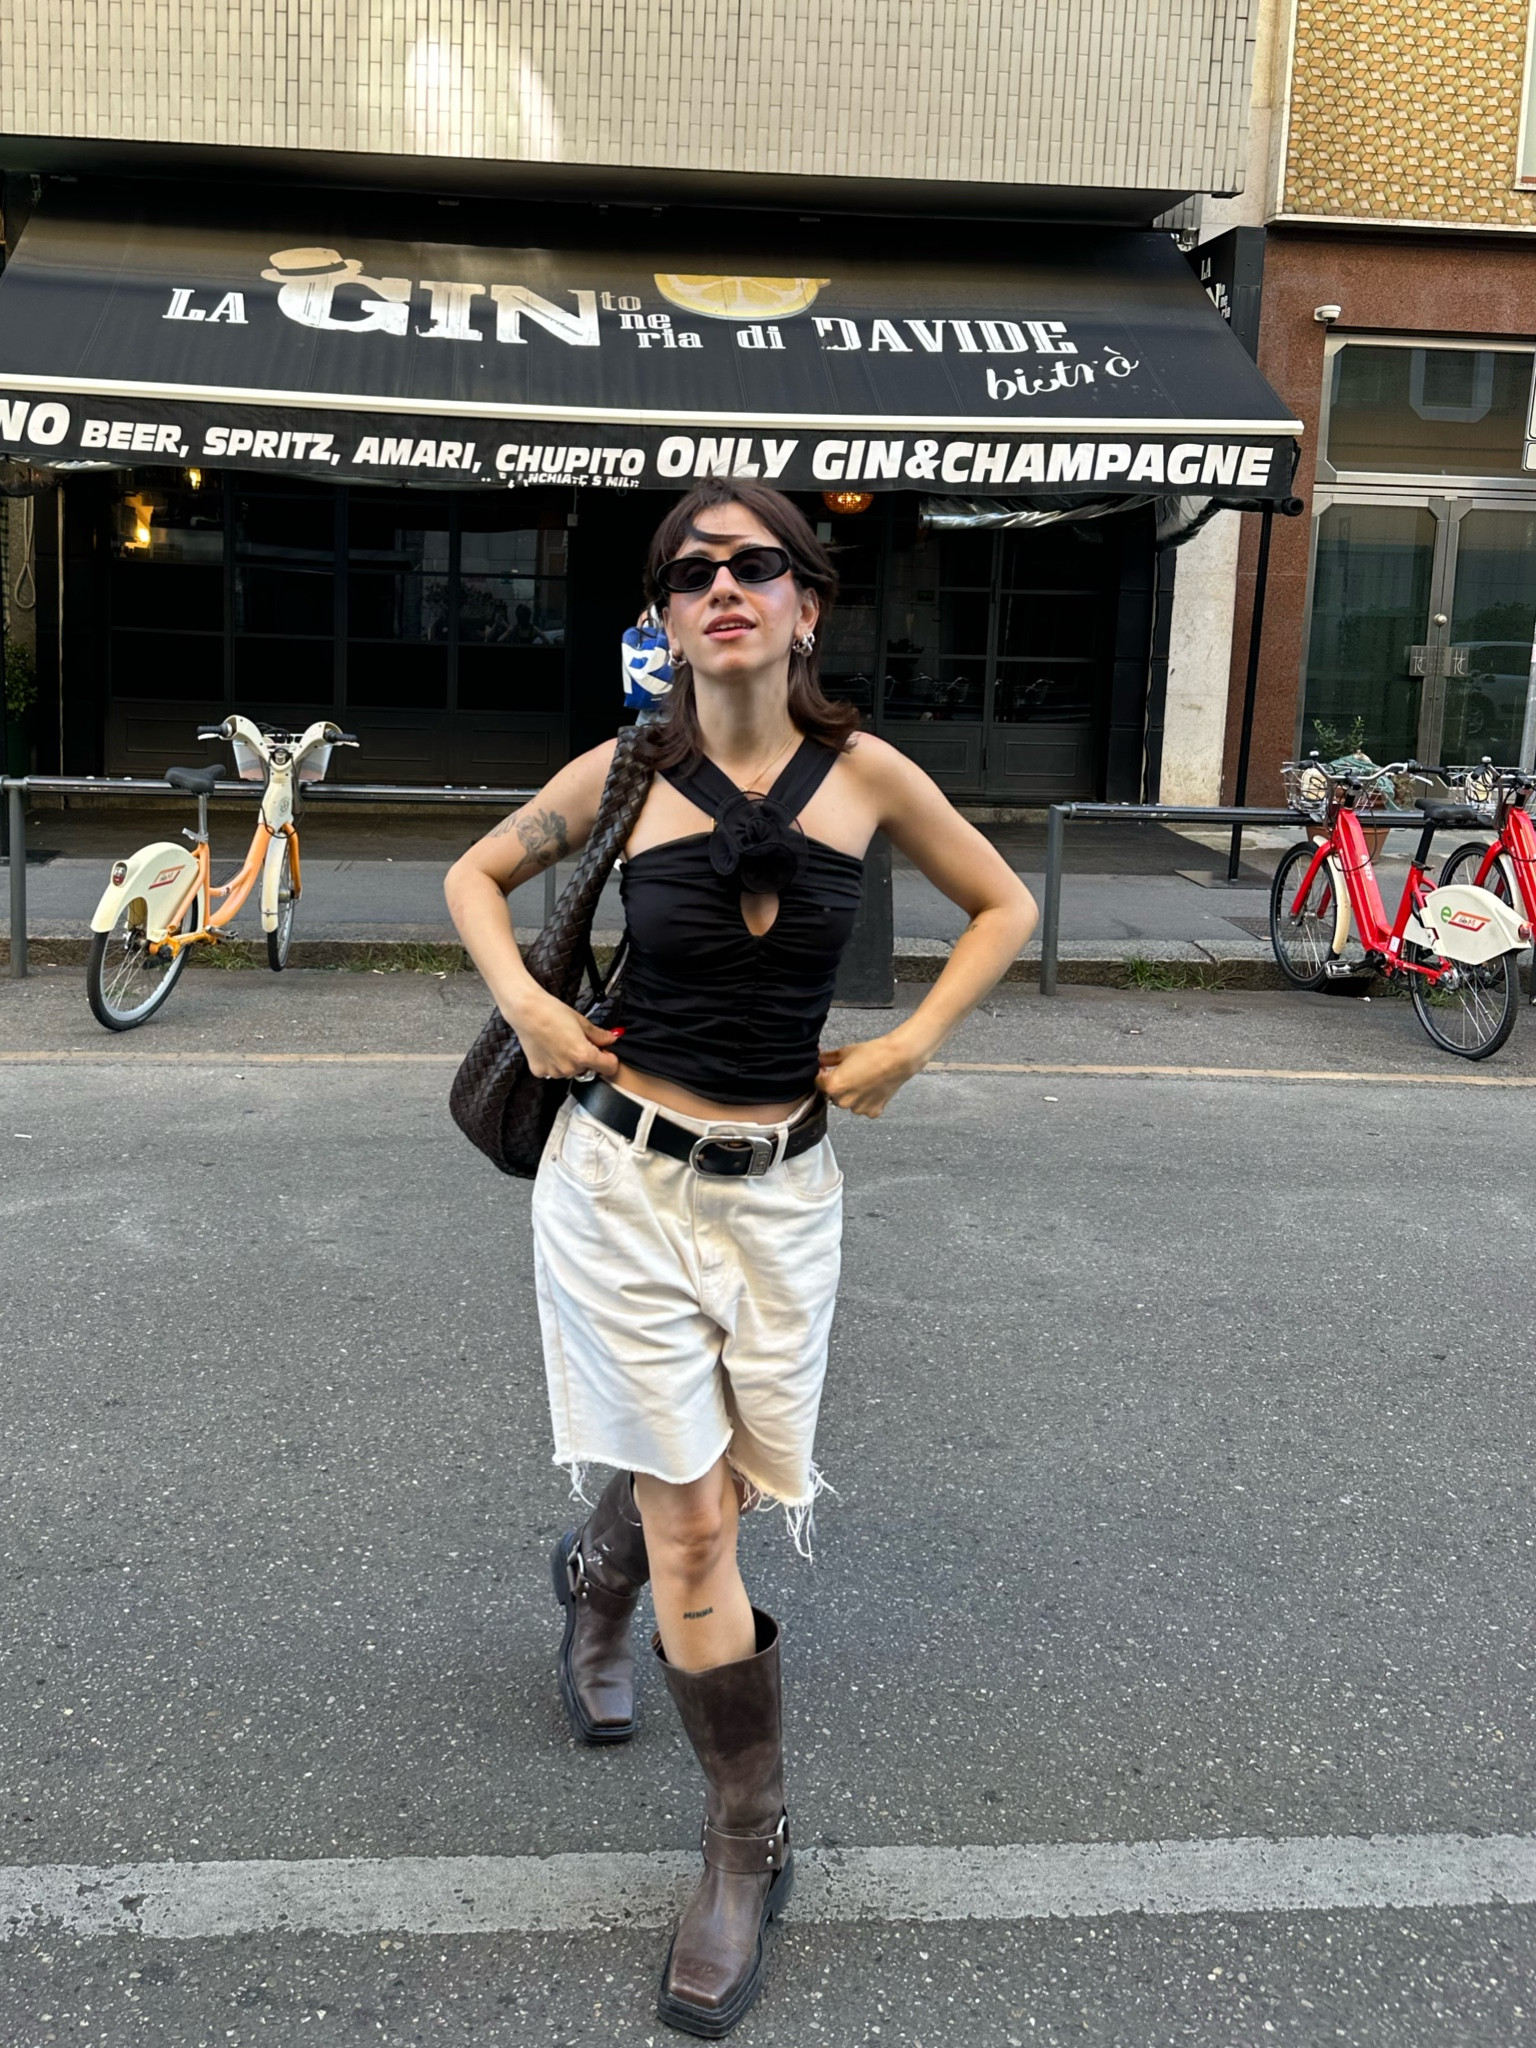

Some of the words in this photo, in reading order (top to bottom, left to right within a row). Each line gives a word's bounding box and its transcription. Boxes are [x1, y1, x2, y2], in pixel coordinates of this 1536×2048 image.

[162, 287, 249, 324] LA
[277, 275, 601, 347] GIN
[600, 291, 642, 312] to
[618, 313, 674, 331] ne
[636, 329, 704, 349] ria
[736, 325, 787, 350] di
[811, 316, 1079, 354] DAVIDE
[0, 398, 71, 446] NO
[79, 419, 190, 458] BEER,
[202, 426, 341, 466] SPRITZ,
[352, 436, 482, 474] AMARI,
[495, 443, 646, 477] CHUPITO
[656, 436, 799, 480] ONLY
[812, 439, 1275, 487] GIN&CHAMPAGNE
